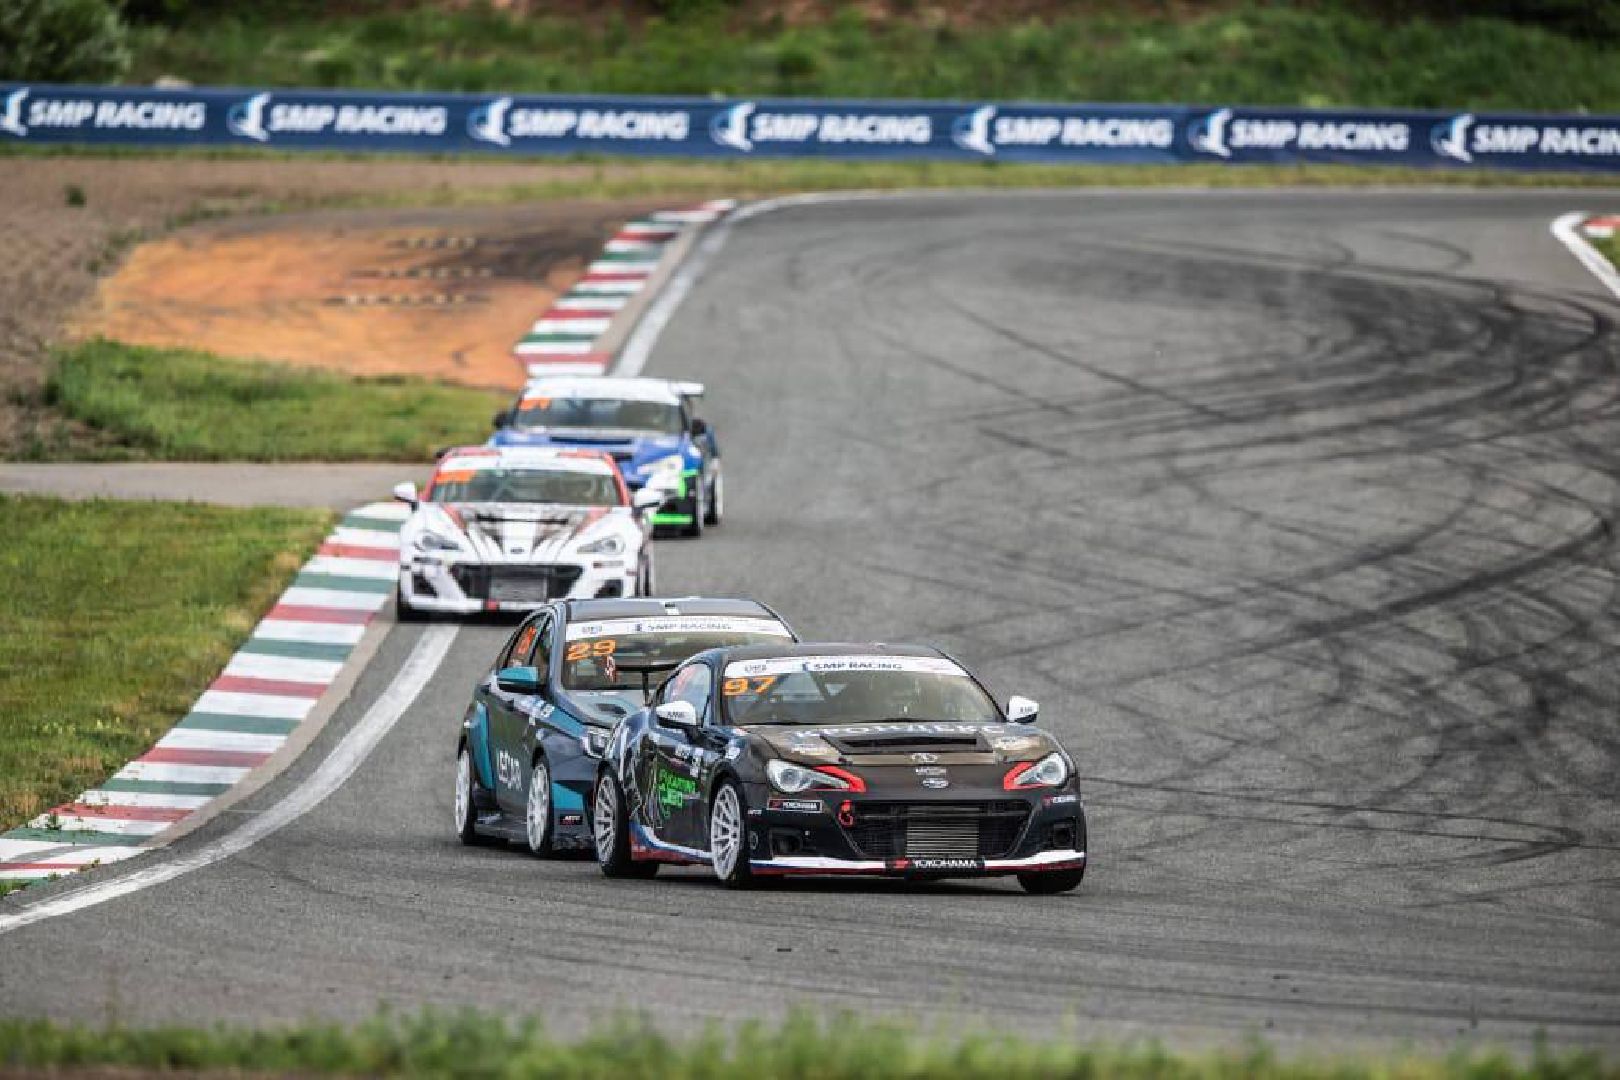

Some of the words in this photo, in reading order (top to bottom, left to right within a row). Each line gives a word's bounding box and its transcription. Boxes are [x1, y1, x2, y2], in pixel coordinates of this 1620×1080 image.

[28, 100, 95, 127] SMP
[94, 101, 207, 130] RACING
[270, 104, 336, 132] SMP
[334, 105, 447, 135] RACING
[509, 109, 578, 137] SMP
[575, 109, 691, 140] RACING
[751, 113, 819, 142] SMP
[818, 114, 931, 143] RACING
[995, 116, 1062, 145] SMP
[1061, 117, 1174, 147] RACING
[1231, 119, 1297, 147] SMP
[1297, 121, 1410, 151] RACING
[1472, 125, 1540, 153] SMP
[1538, 126, 1620, 155] RACIN
[567, 639, 616, 661] 29
[813, 662, 846, 670] SMP
[849, 662, 902, 670] RACING
[723, 676, 777, 696] 97
[913, 859, 978, 869] YOKOHAMA
